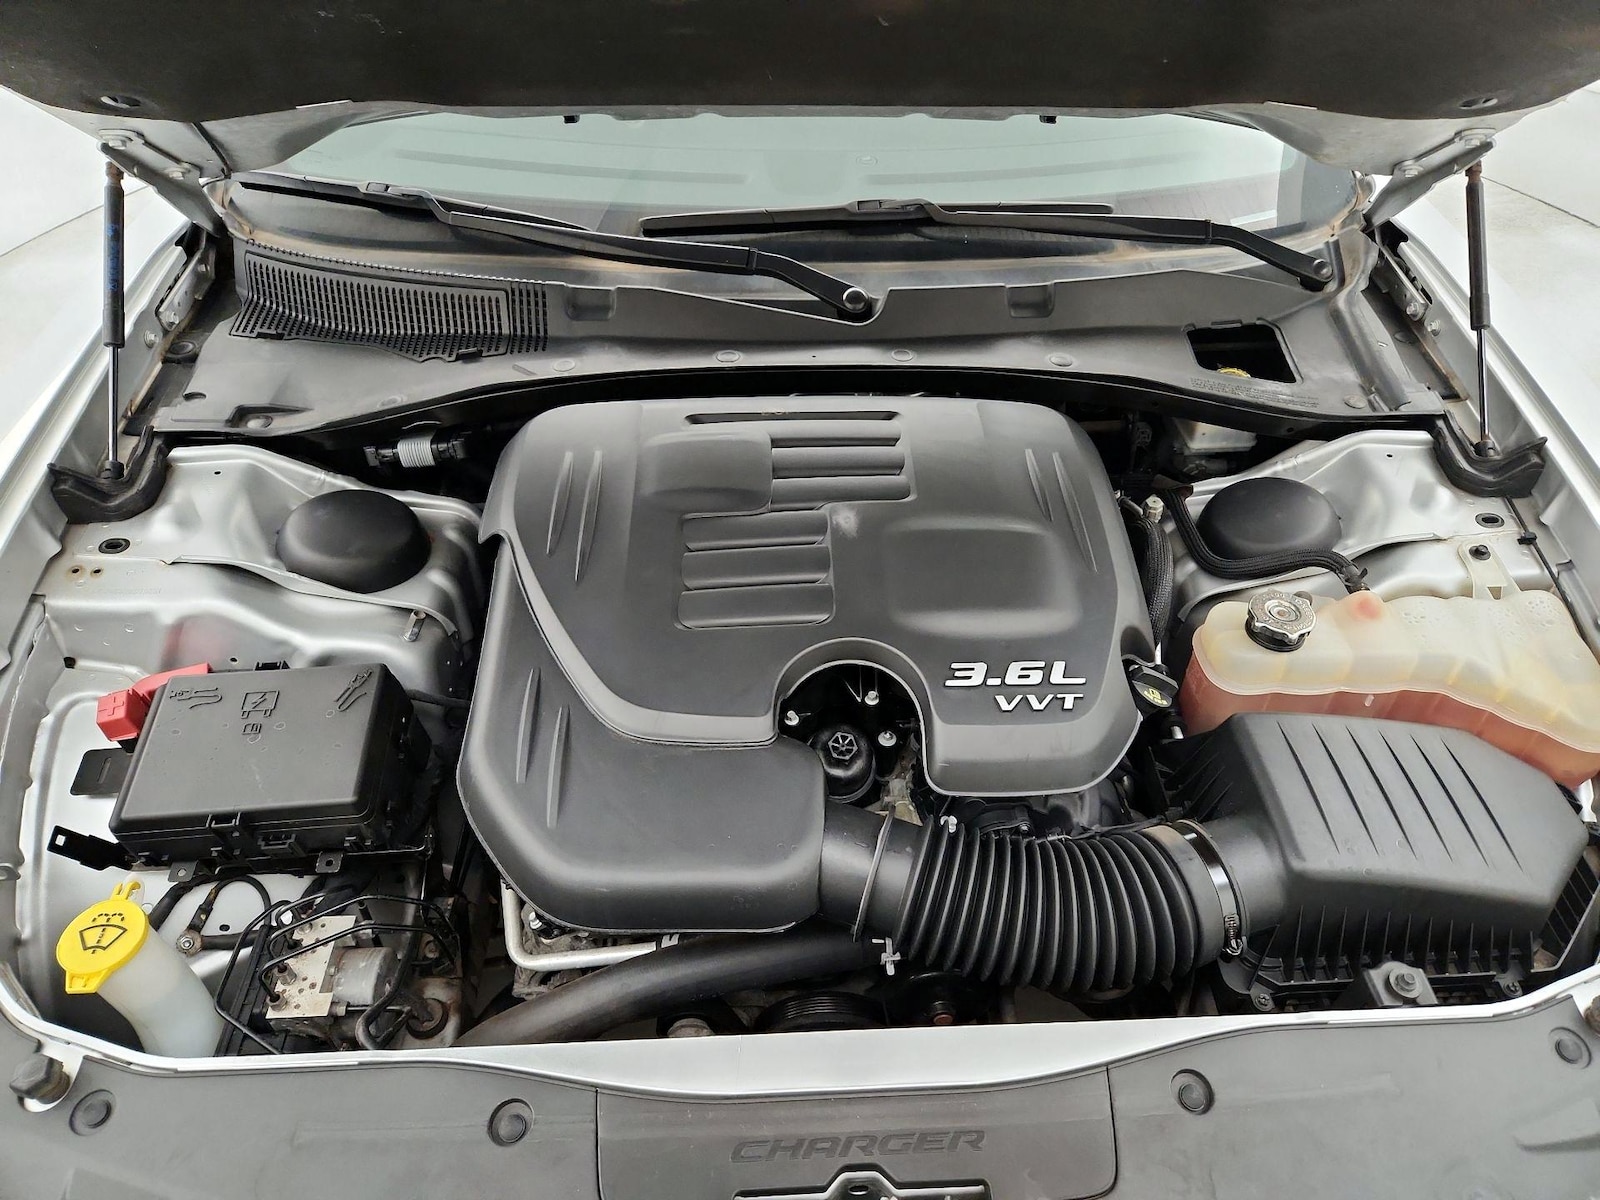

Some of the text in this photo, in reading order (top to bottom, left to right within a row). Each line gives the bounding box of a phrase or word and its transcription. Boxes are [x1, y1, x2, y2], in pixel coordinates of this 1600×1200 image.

[944, 660, 1087, 687] 3.6L
[994, 693, 1084, 712] VVT
[730, 1129, 986, 1164] CHARGER
